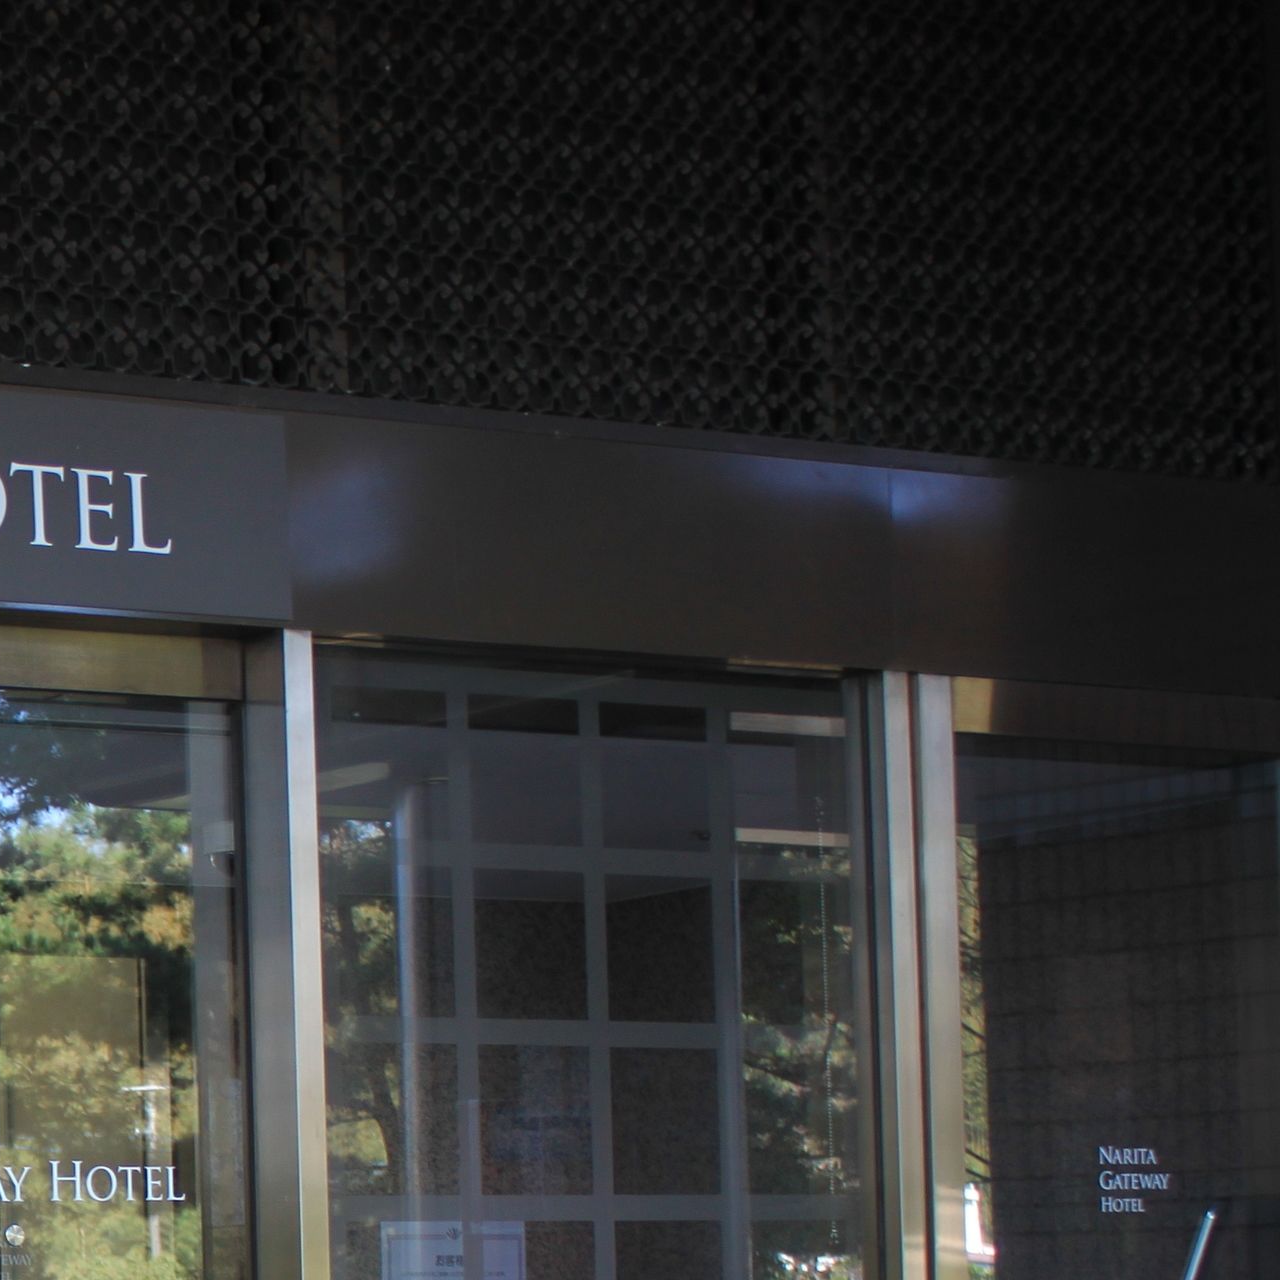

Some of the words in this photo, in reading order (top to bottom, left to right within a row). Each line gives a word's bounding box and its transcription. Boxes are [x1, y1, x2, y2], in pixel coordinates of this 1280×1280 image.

[1098, 1145, 1158, 1165] NARITA
[49, 1160, 186, 1202] HOTEL
[1099, 1170, 1170, 1190] GATEWAY
[1101, 1196, 1146, 1213] HOTEL
